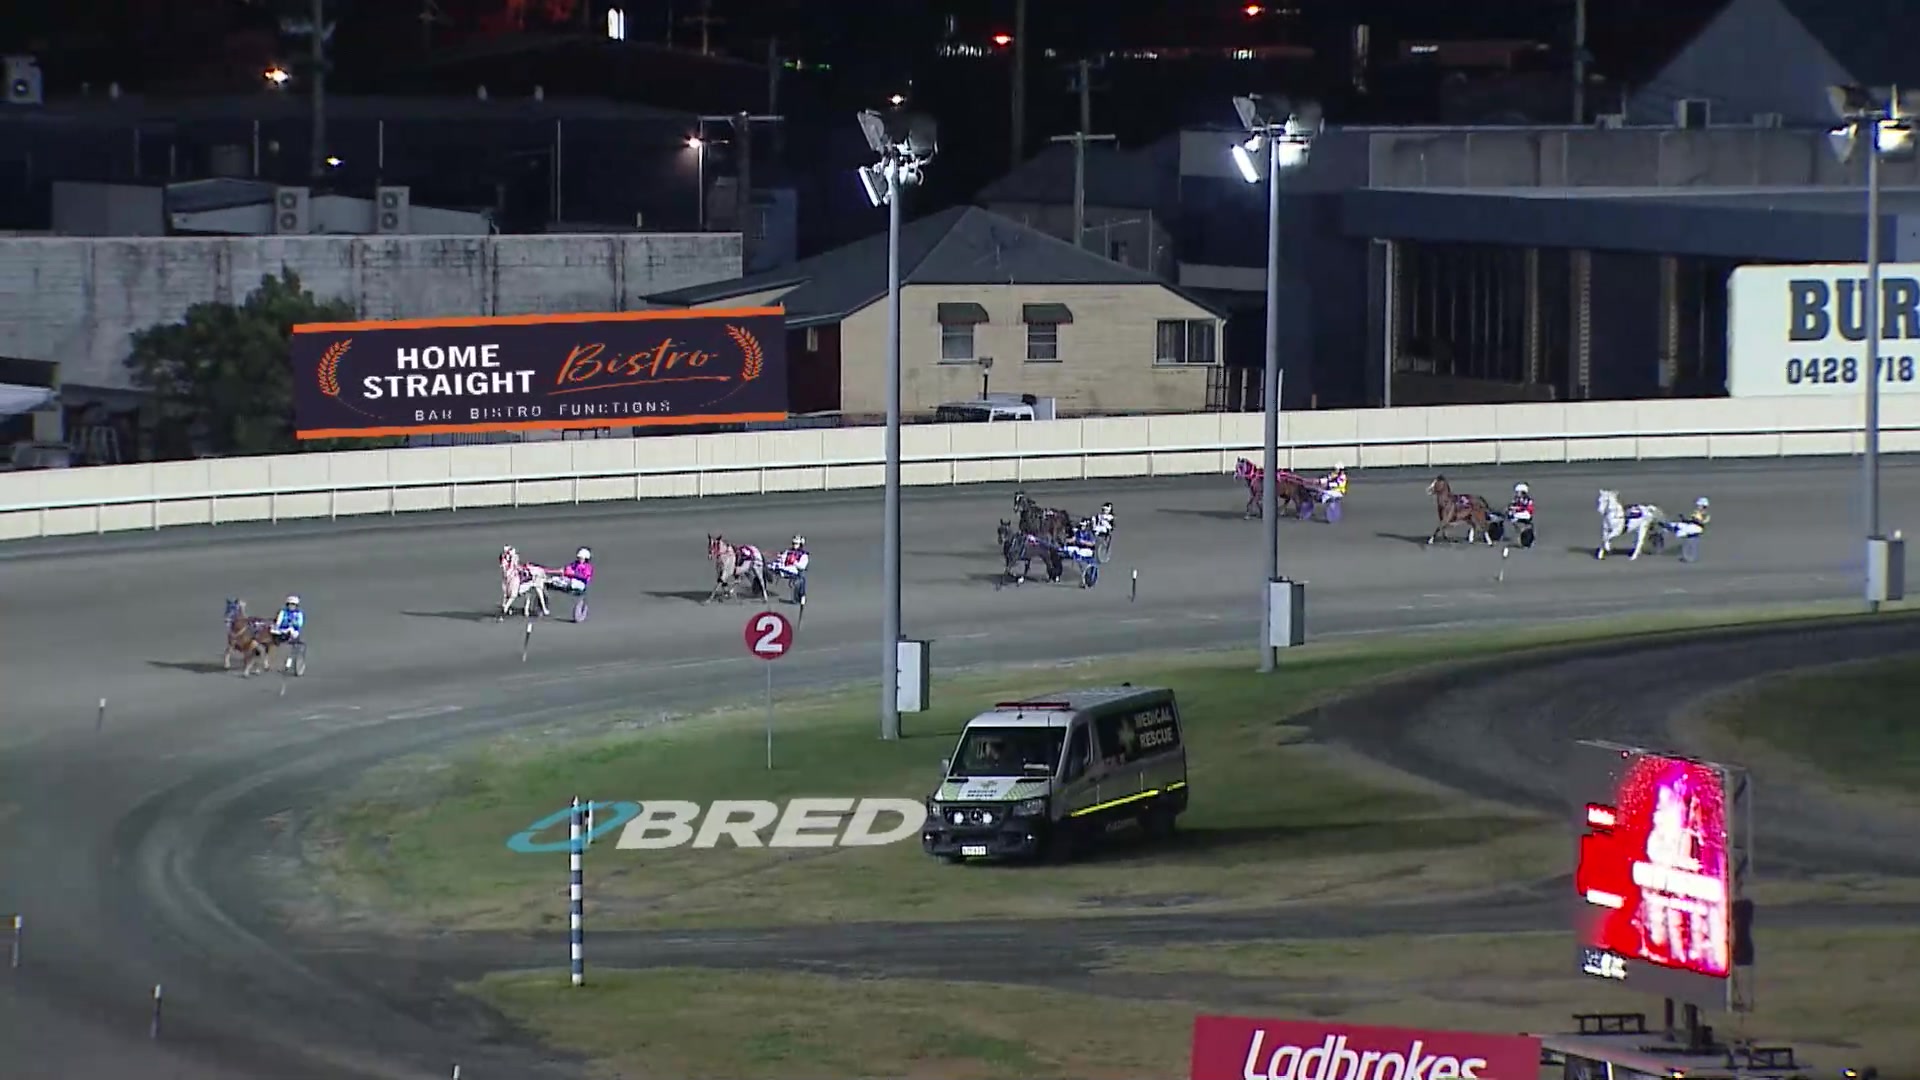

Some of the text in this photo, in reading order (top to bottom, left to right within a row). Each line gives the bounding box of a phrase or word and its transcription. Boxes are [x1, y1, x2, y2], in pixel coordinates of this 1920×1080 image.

[397, 344, 500, 369] HOME
[556, 338, 719, 385] Bistro
[1787, 356, 1858, 384] 0428
[363, 370, 536, 399] STRAIGHT
[415, 400, 671, 421] BAR BISTRO FUNCTIONS
[755, 615, 783, 652] 2
[1134, 706, 1174, 728] MEDICAL
[1140, 727, 1174, 748] RESCUE
[1243, 1029, 1487, 1080] Ladbrokes
